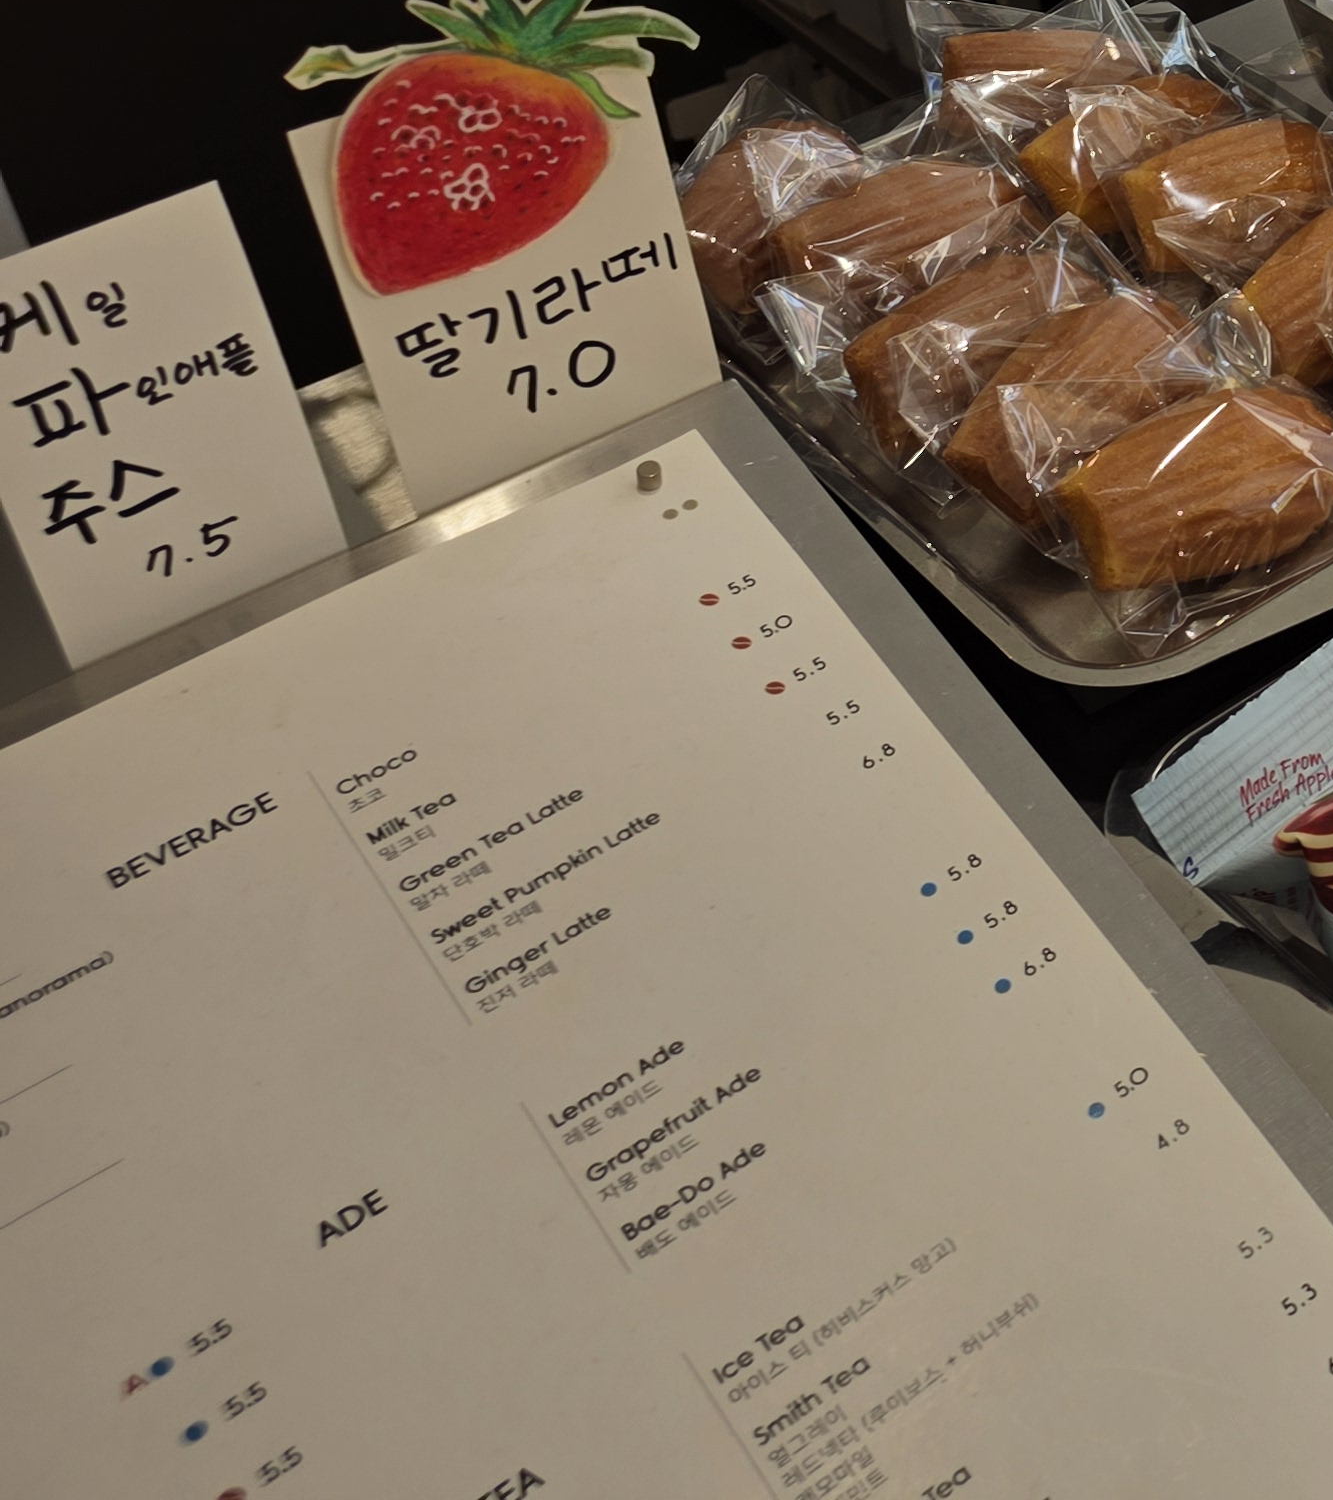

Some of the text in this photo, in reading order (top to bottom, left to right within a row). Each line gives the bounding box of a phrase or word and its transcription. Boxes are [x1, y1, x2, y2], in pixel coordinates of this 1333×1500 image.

[394, 231, 679, 380] 딸기라떼
[12, 332, 259, 449] 파인애플
[506, 339, 617, 414] 7.0
[42, 459, 181, 544] 주스
[145, 514, 240, 578] 7.5
[727, 574, 758, 598] 5.5
[760, 613, 794, 641] 5.0
[793, 654, 828, 684] 5.5
[825, 698, 862, 729] 5.5
[336, 748, 418, 797] Choco
[861, 741, 897, 772] 6.8
[347, 786, 388, 815] 초코
[1238, 751, 1326, 808] Made From
[365, 791, 459, 846] Milk Tea
[1244, 788, 1291, 828] Fresh
[105, 790, 279, 891] BEVERAGE
[376, 823, 438, 863] 밀크티
[398, 784, 586, 896] Green Tea Latte
[430, 810, 662, 946] Sweet Pumpkin Latte
[946, 852, 983, 884] 5.8
[409, 881, 452, 913] 말차
[983, 899, 1020, 932] 5.8
[440, 921, 503, 964] 단호박
[463, 903, 613, 998] Ginger Latte
[1022, 946, 1058, 979] 6.8
[475, 982, 520, 1016] 진저
[548, 1037, 687, 1131] Lemon Ade
[1113, 1065, 1151, 1100] 5.0
[561, 1114, 605, 1150] 레몬
[584, 1063, 763, 1186] Grapefruit Ade
[1156, 1118, 1192, 1153] 4.8
[596, 1169, 640, 1206] 자몽
[620, 1138, 768, 1244] Bae-Do Ade
[317, 1187, 390, 1249] ADE
[1237, 1225, 1275, 1261] 5.3
[727, 1361, 789, 1405] 아이스
[788, 1341, 813, 1363] 티
[909, 1236, 958, 1276] 망고)
[1281, 1282, 1319, 1319] 5.3
[186, 1317, 234, 1357] 5.5
[711, 1314, 805, 1385] Ice Tea
[219, 1380, 268, 1422] 5.5
[752, 1356, 873, 1447] Smith Tea
[767, 1403, 849, 1469] 얼그레이
[255, 1445, 304, 1488] 5.5
[922, 1466, 972, 1500] Tea
